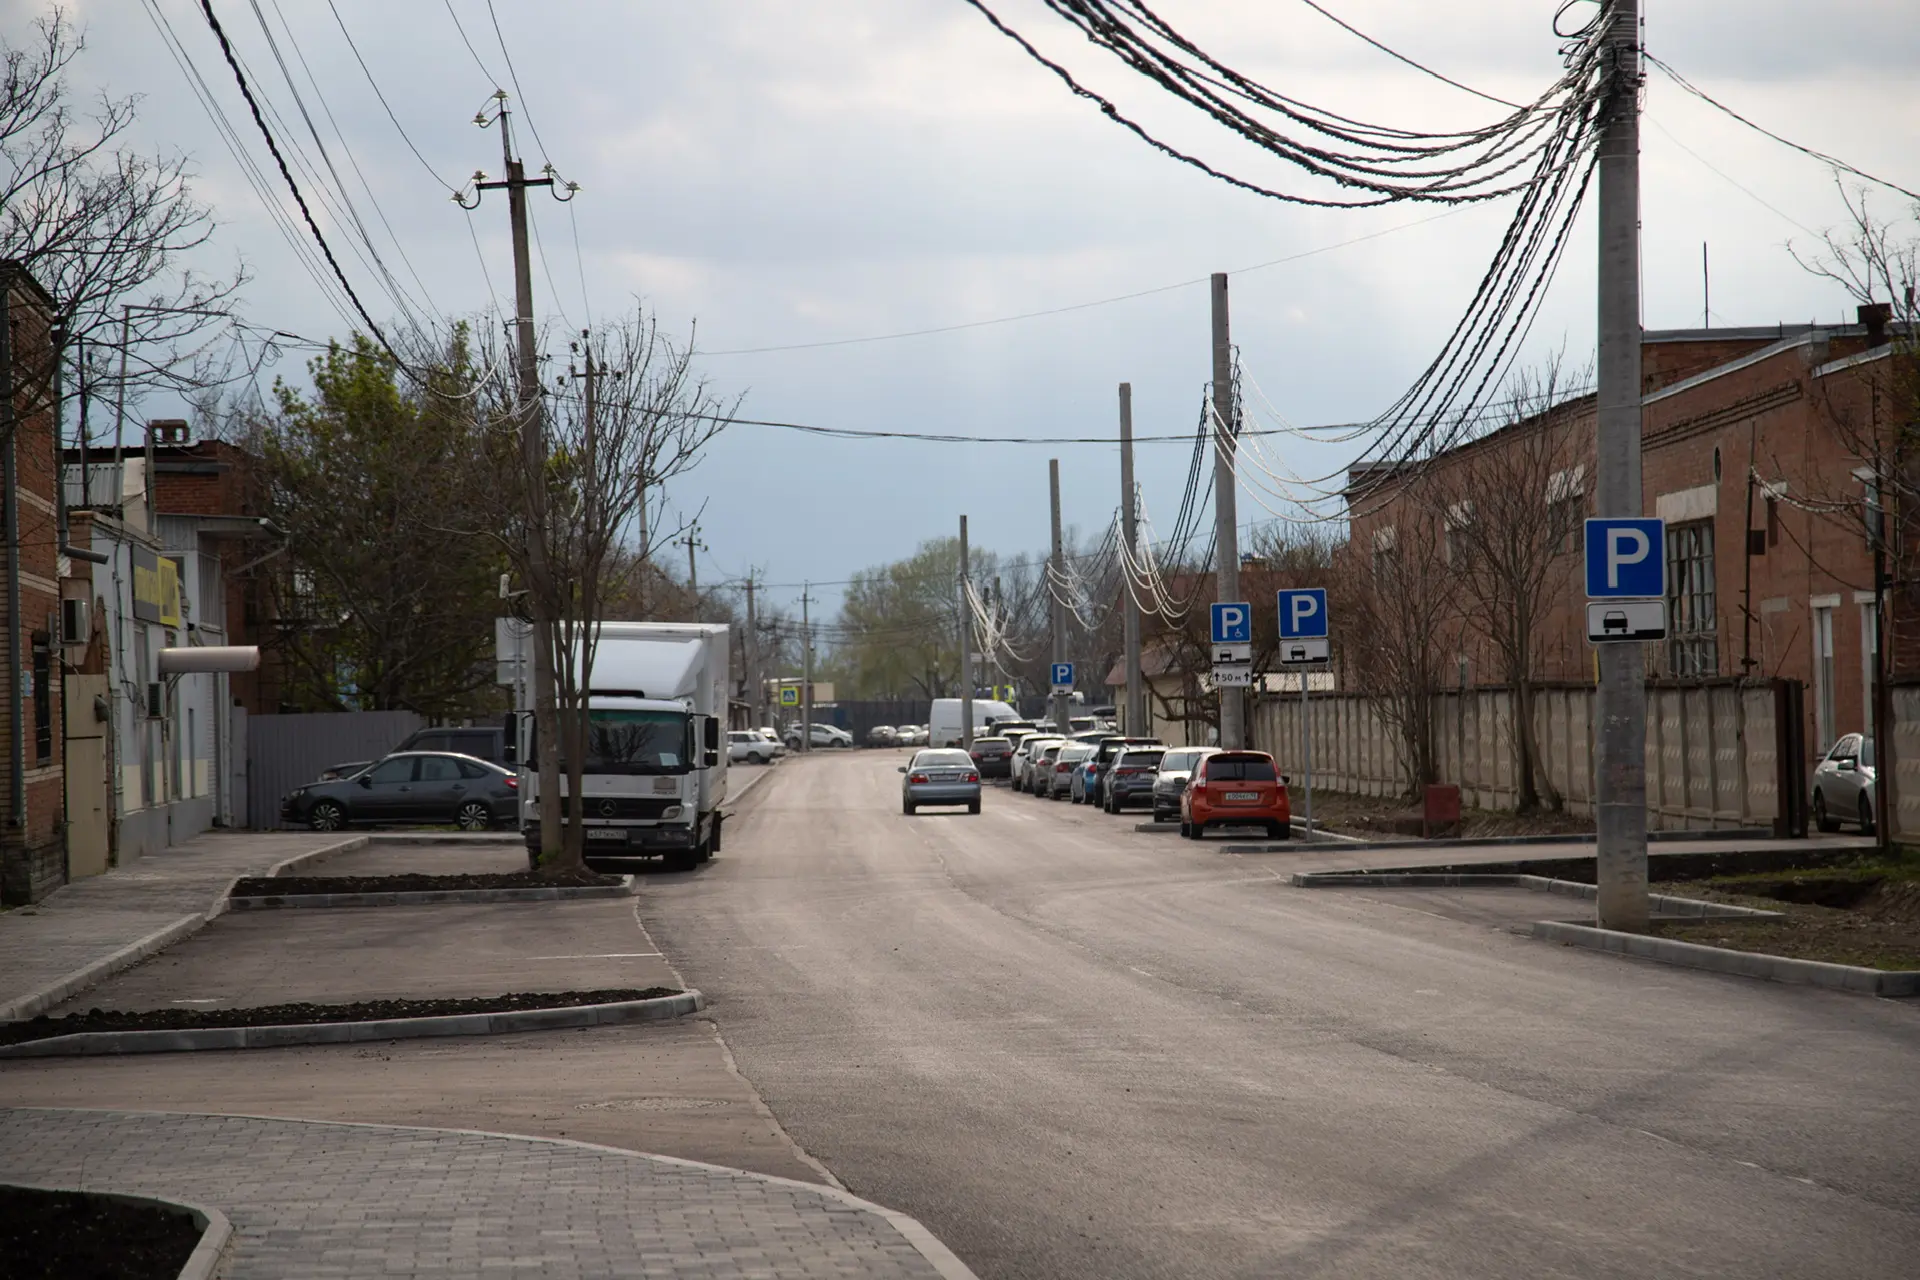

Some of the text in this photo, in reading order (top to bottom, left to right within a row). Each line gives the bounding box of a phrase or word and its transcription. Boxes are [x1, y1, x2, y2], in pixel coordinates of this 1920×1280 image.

[1607, 528, 1650, 588] P
[1222, 608, 1243, 639] P
[1291, 595, 1318, 632] P
[1057, 666, 1069, 683] P
[1222, 674, 1233, 682] 50
